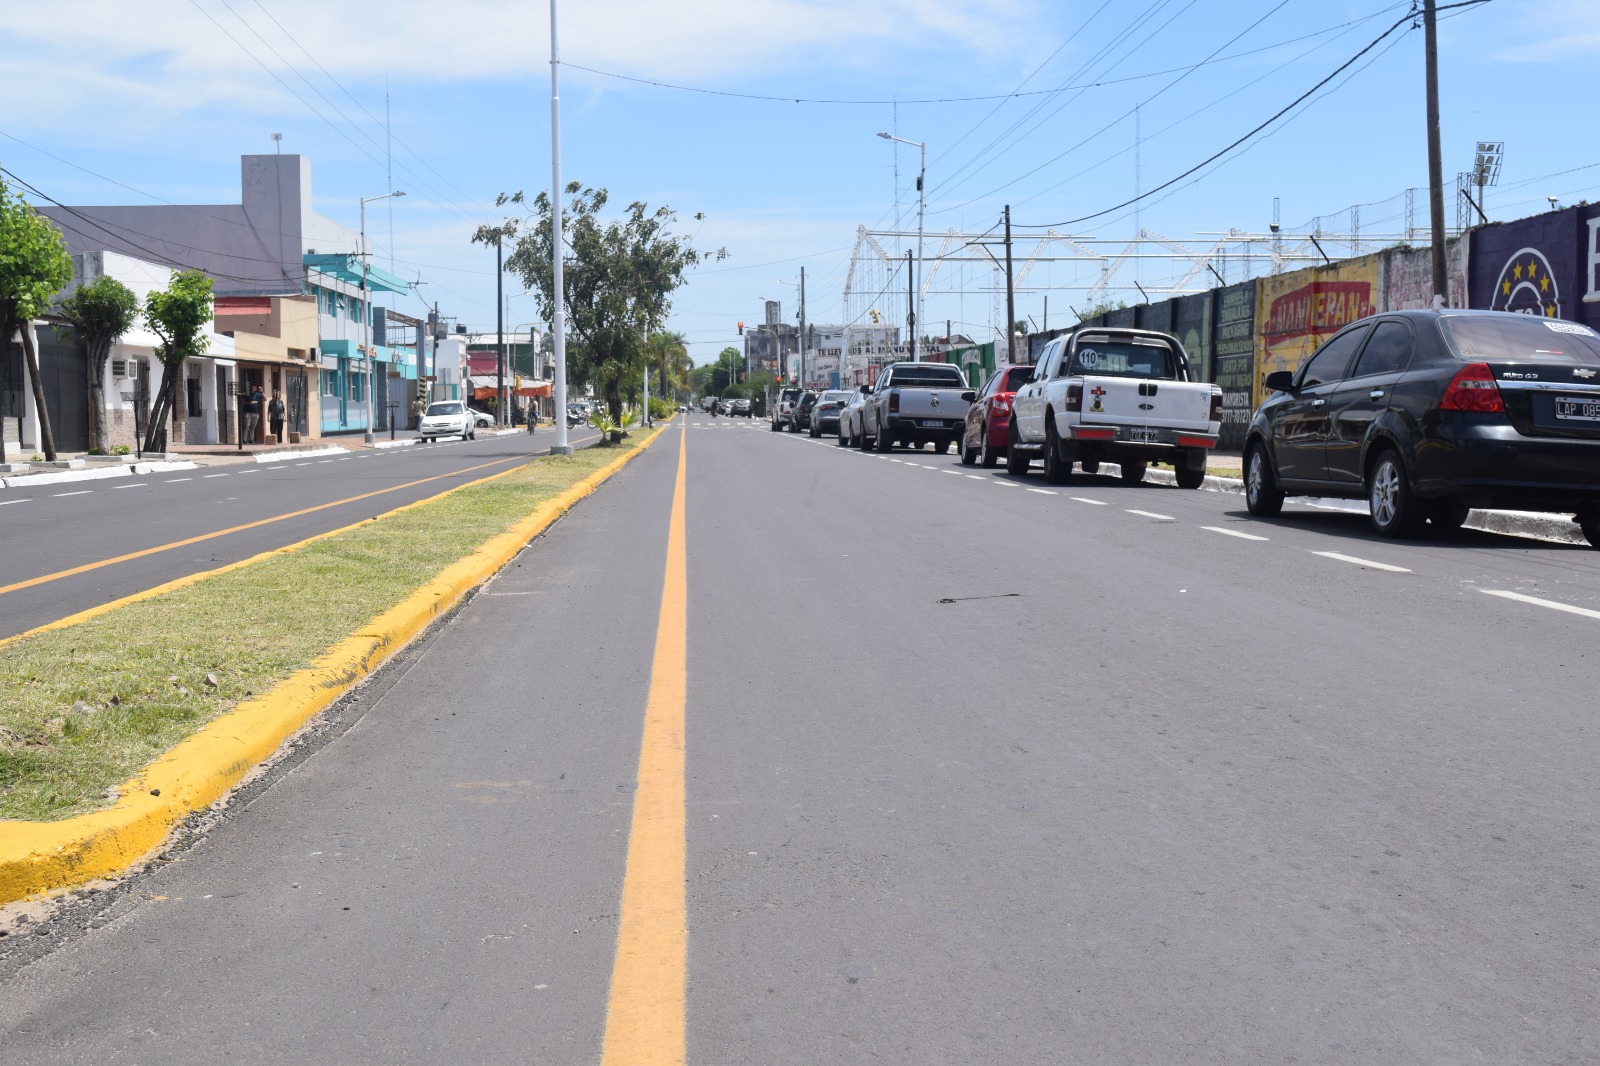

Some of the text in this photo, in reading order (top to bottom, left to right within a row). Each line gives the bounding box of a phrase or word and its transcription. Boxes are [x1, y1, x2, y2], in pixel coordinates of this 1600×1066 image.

[1080, 352, 1096, 364] 110
[1237, 358, 1248, 372] POR
[1222, 392, 1249, 407] MAYORISTA
[1557, 403, 1600, 417] LAP 085
